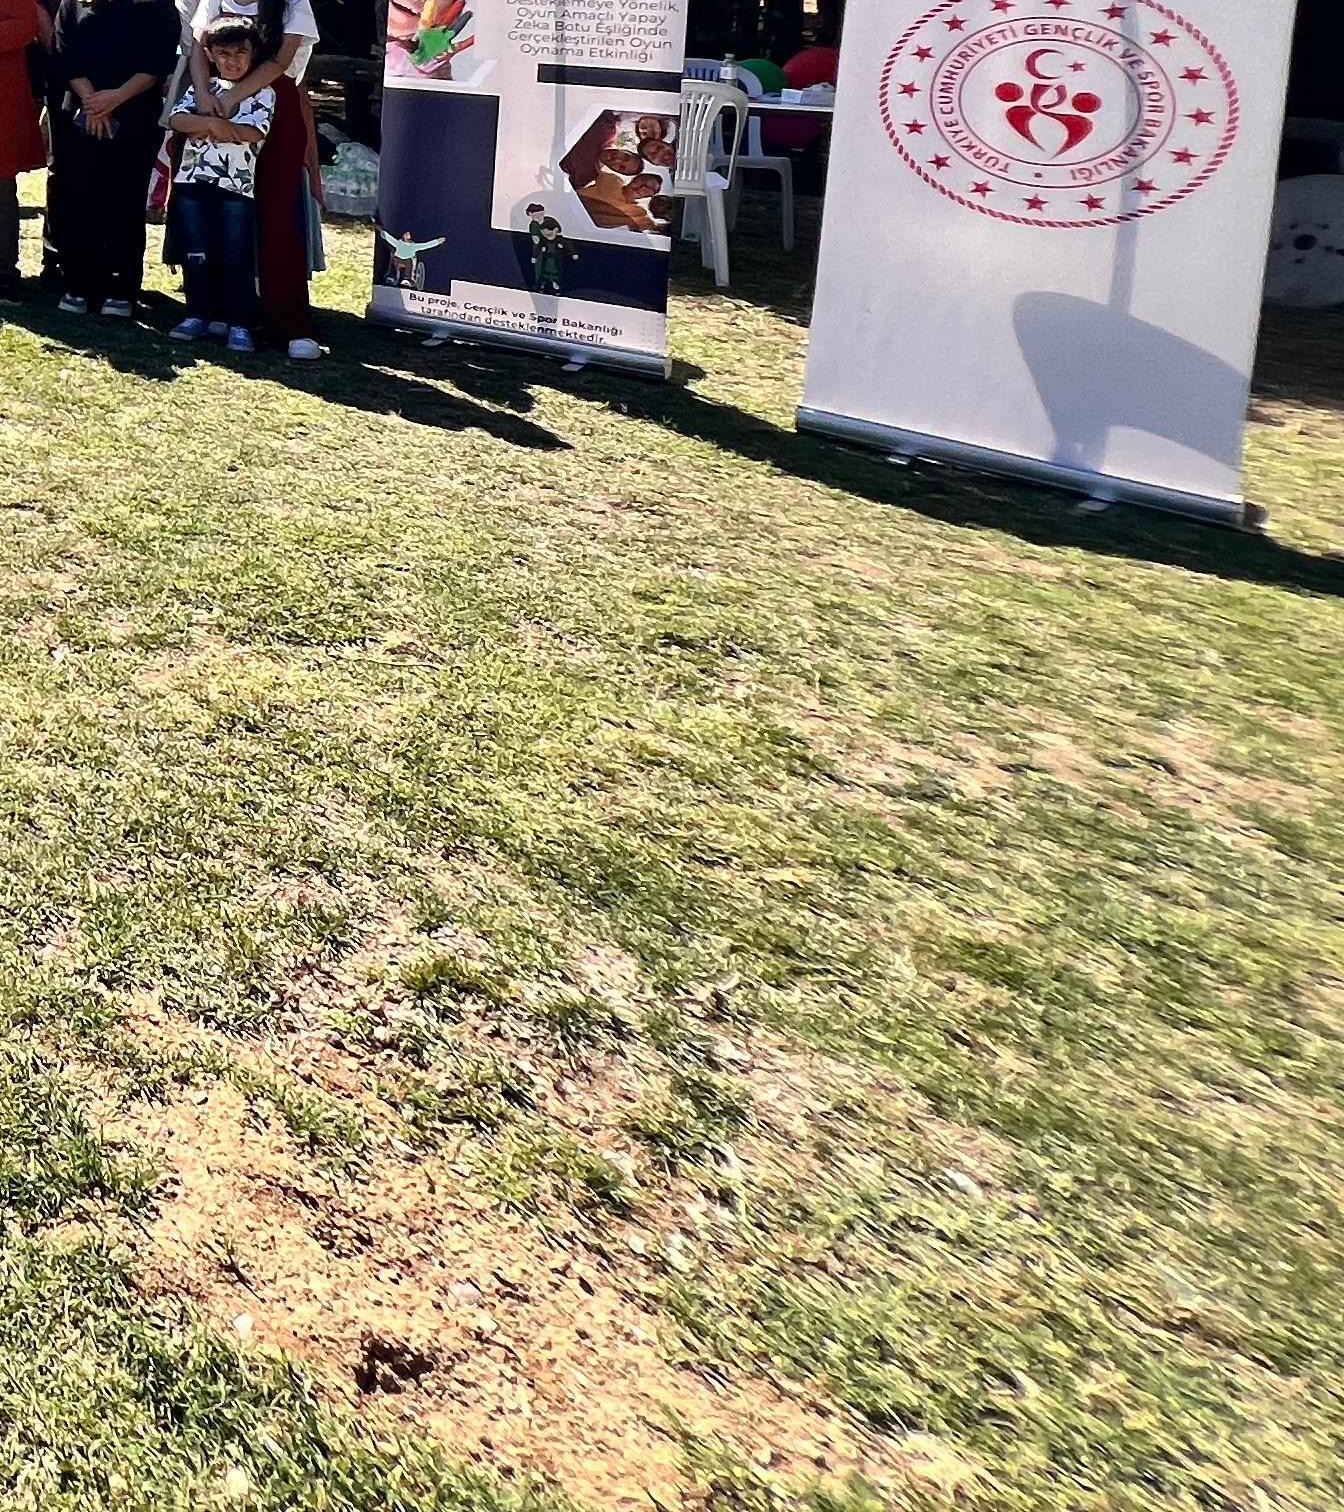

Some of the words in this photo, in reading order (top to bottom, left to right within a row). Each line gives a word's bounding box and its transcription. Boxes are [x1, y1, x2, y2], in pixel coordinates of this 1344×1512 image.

[514, 19, 549, 30] Zeka
[555, 20, 590, 32] Botu
[595, 22, 668, 37] Eşliğinde
[517, 7, 556, 19] Oyun
[561, 9, 614, 23] Amaçlı
[619, 12, 666, 25] Yapay
[629, 37, 673, 50] Oyun
[1023, 23, 1119, 51] GENÇLİK
[520, 43, 584, 57] Oynama
[588, 47, 653, 63] Etkinliği
[1118, 47, 1144, 70] VE
[938, 25, 1017, 115] CUMHURİYETİ
[1137, 71, 1165, 114] SPOR
[944, 119, 1010, 174] TÜRKİYE
[1070, 118, 1162, 181] BAKANLIĞI
[409, 292, 424, 302] Bu
[464, 301, 508, 317] Gençlik
[511, 310, 526, 320] ve
[529, 312, 558, 325] Spor
[562, 317, 624, 337] Bakanlığı
